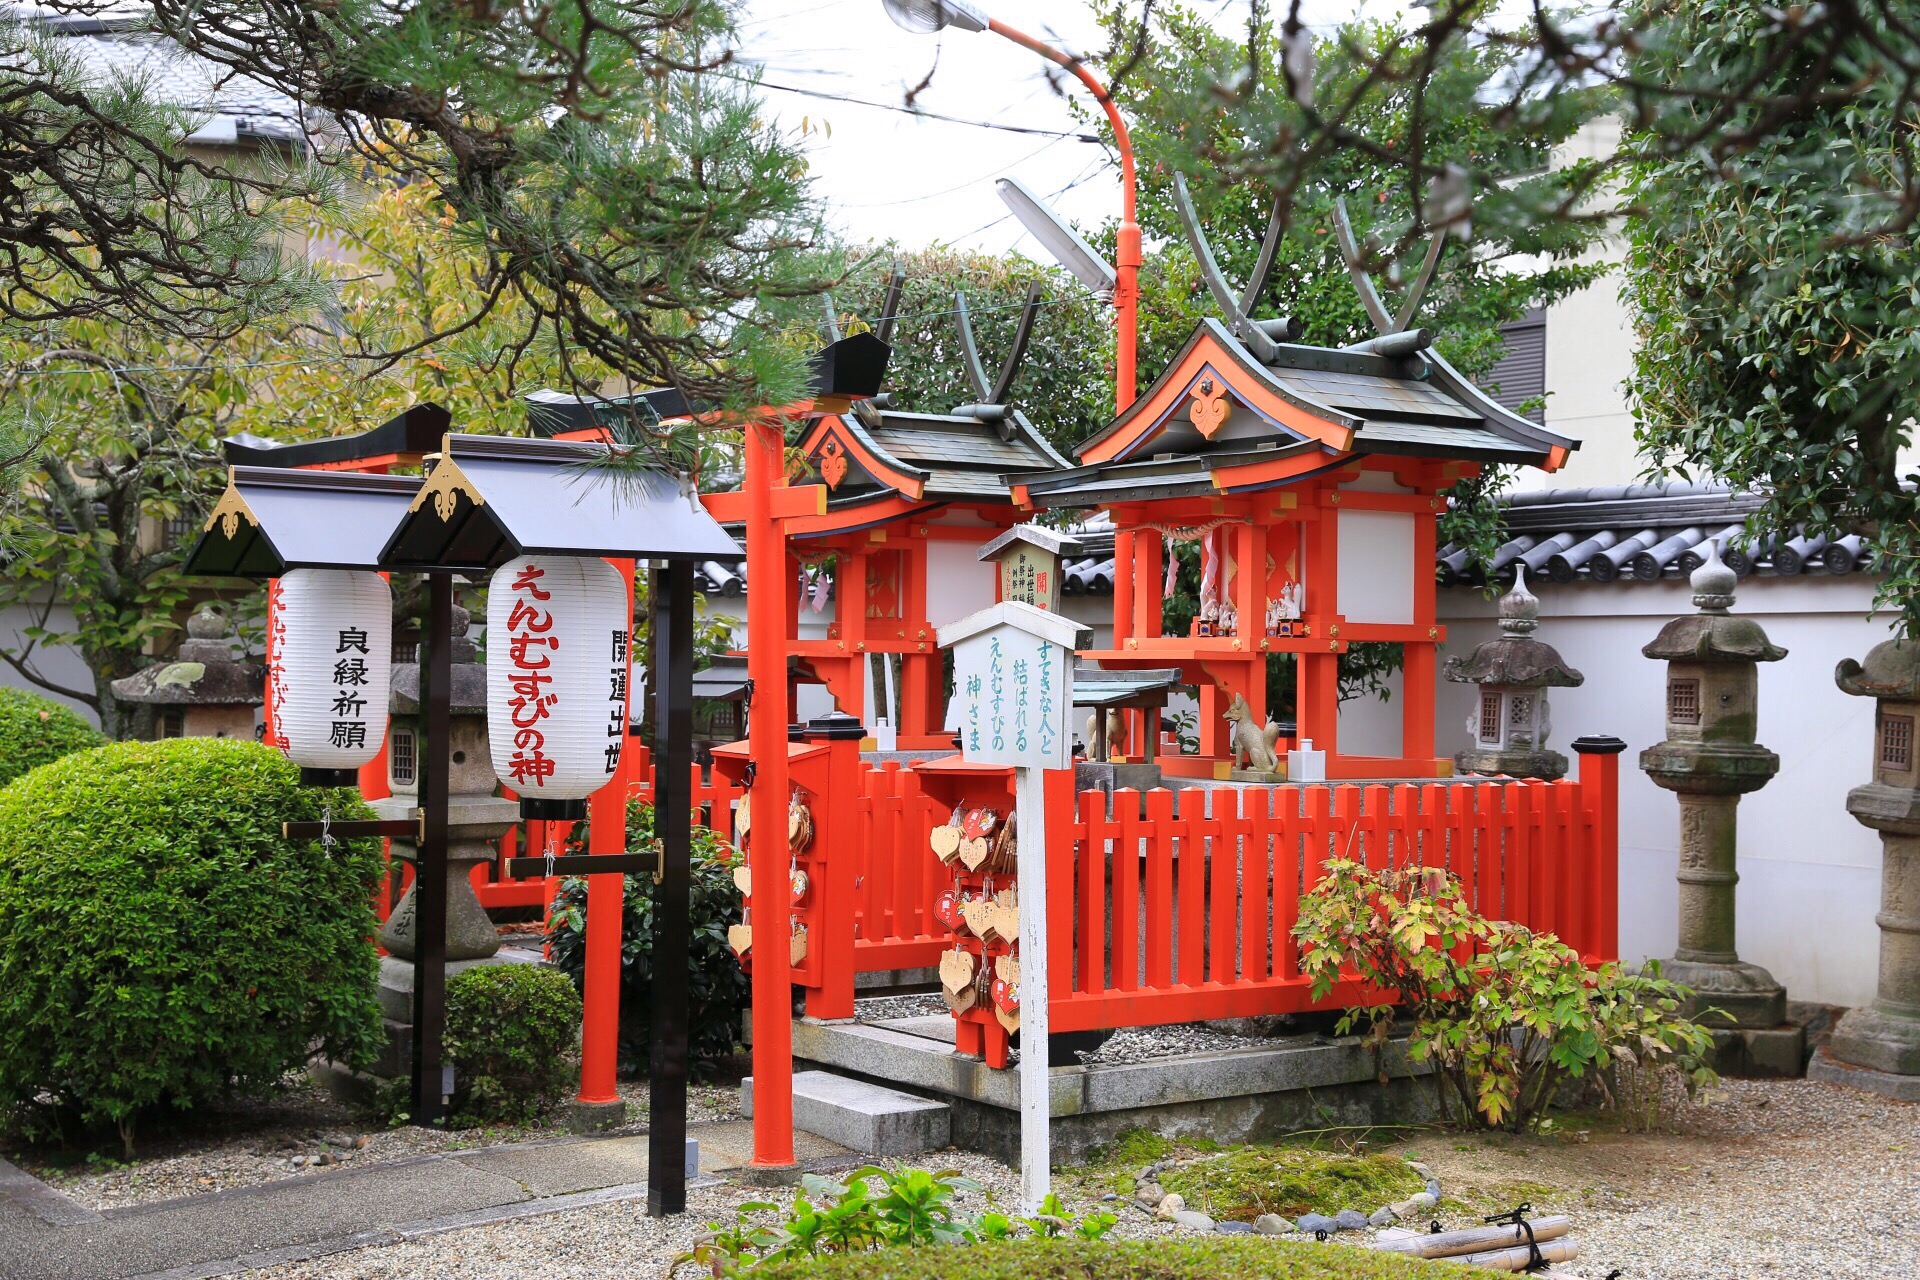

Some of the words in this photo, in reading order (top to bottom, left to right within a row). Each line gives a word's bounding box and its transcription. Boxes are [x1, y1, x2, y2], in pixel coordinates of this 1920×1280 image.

[327, 626, 370, 749] 良縁祈願
[507, 564, 559, 788] えんむすびの神
[965, 673, 982, 752] 神さま
[989, 636, 1005, 751] えんむすびの
[1013, 658, 1029, 752] 結ばれる
[1036, 640, 1056, 755] すてきな人と
